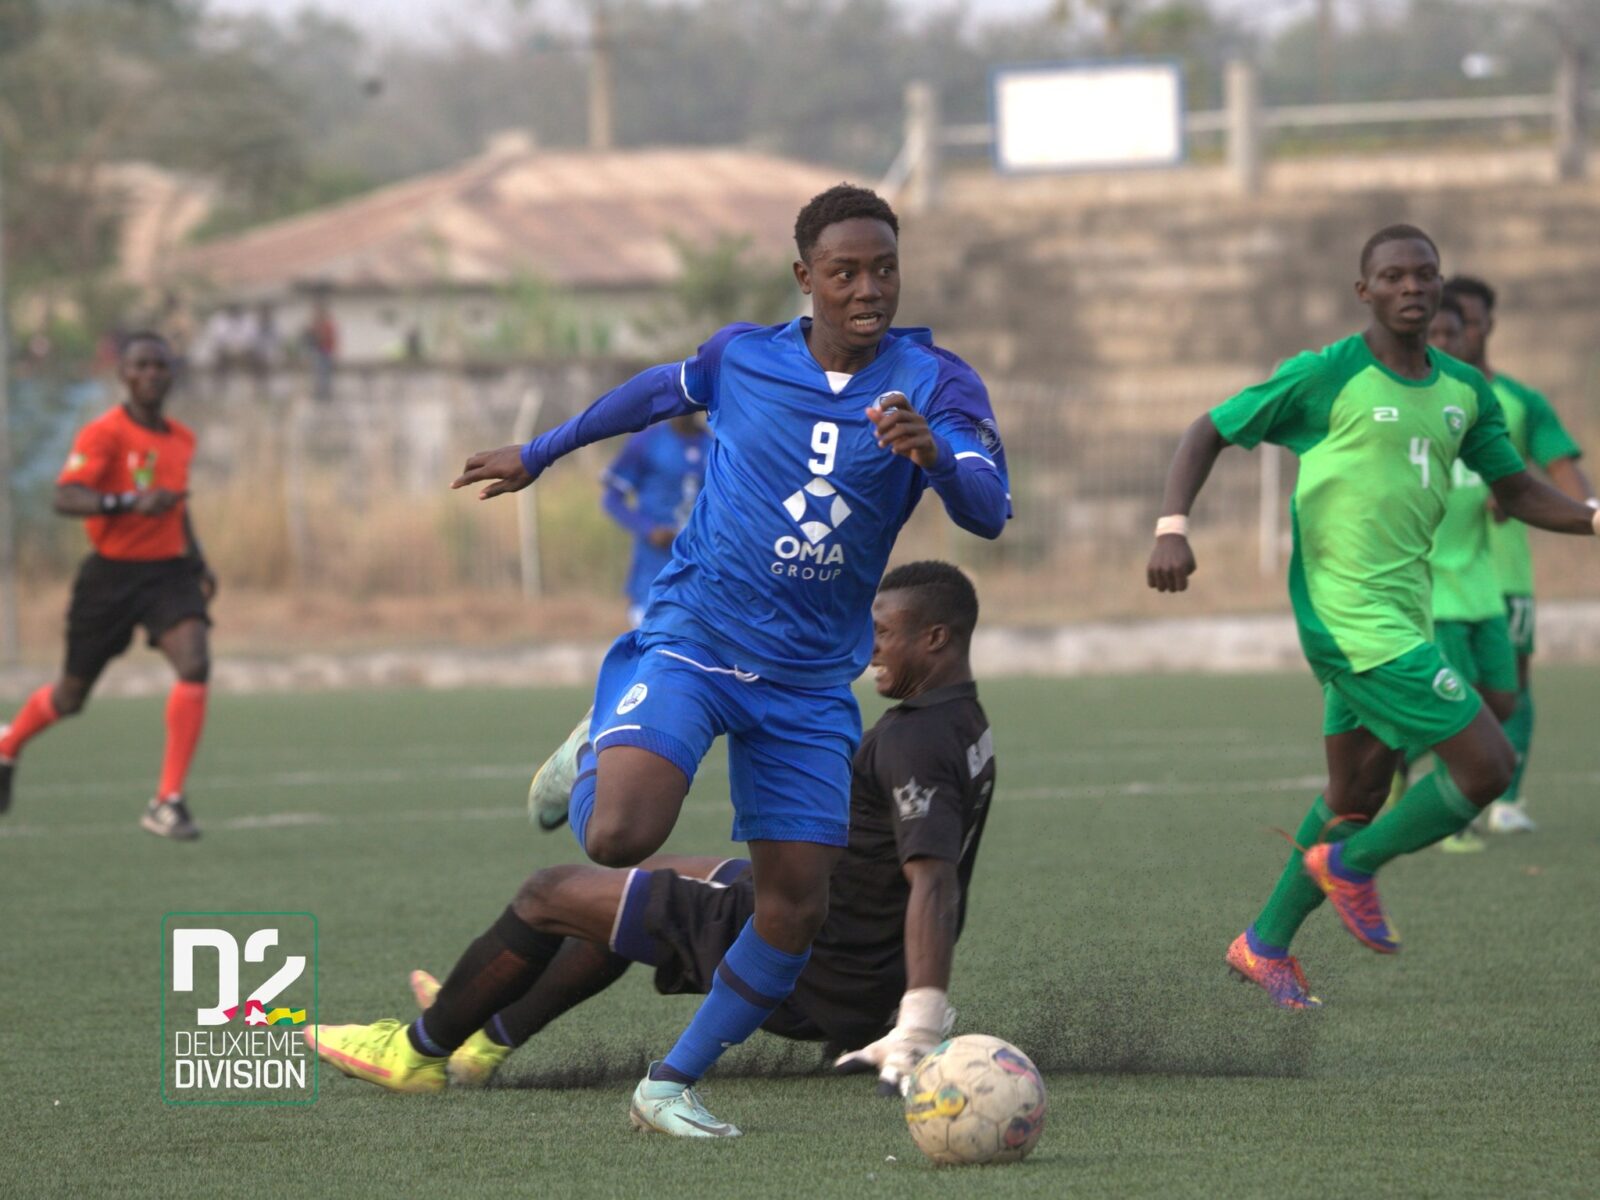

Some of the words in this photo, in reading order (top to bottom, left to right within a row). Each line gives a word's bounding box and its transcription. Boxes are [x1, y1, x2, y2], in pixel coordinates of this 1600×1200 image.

[808, 421, 839, 476] 9
[1410, 436, 1430, 489] 4
[774, 535, 844, 565] OMA
[770, 561, 841, 582] GROUP
